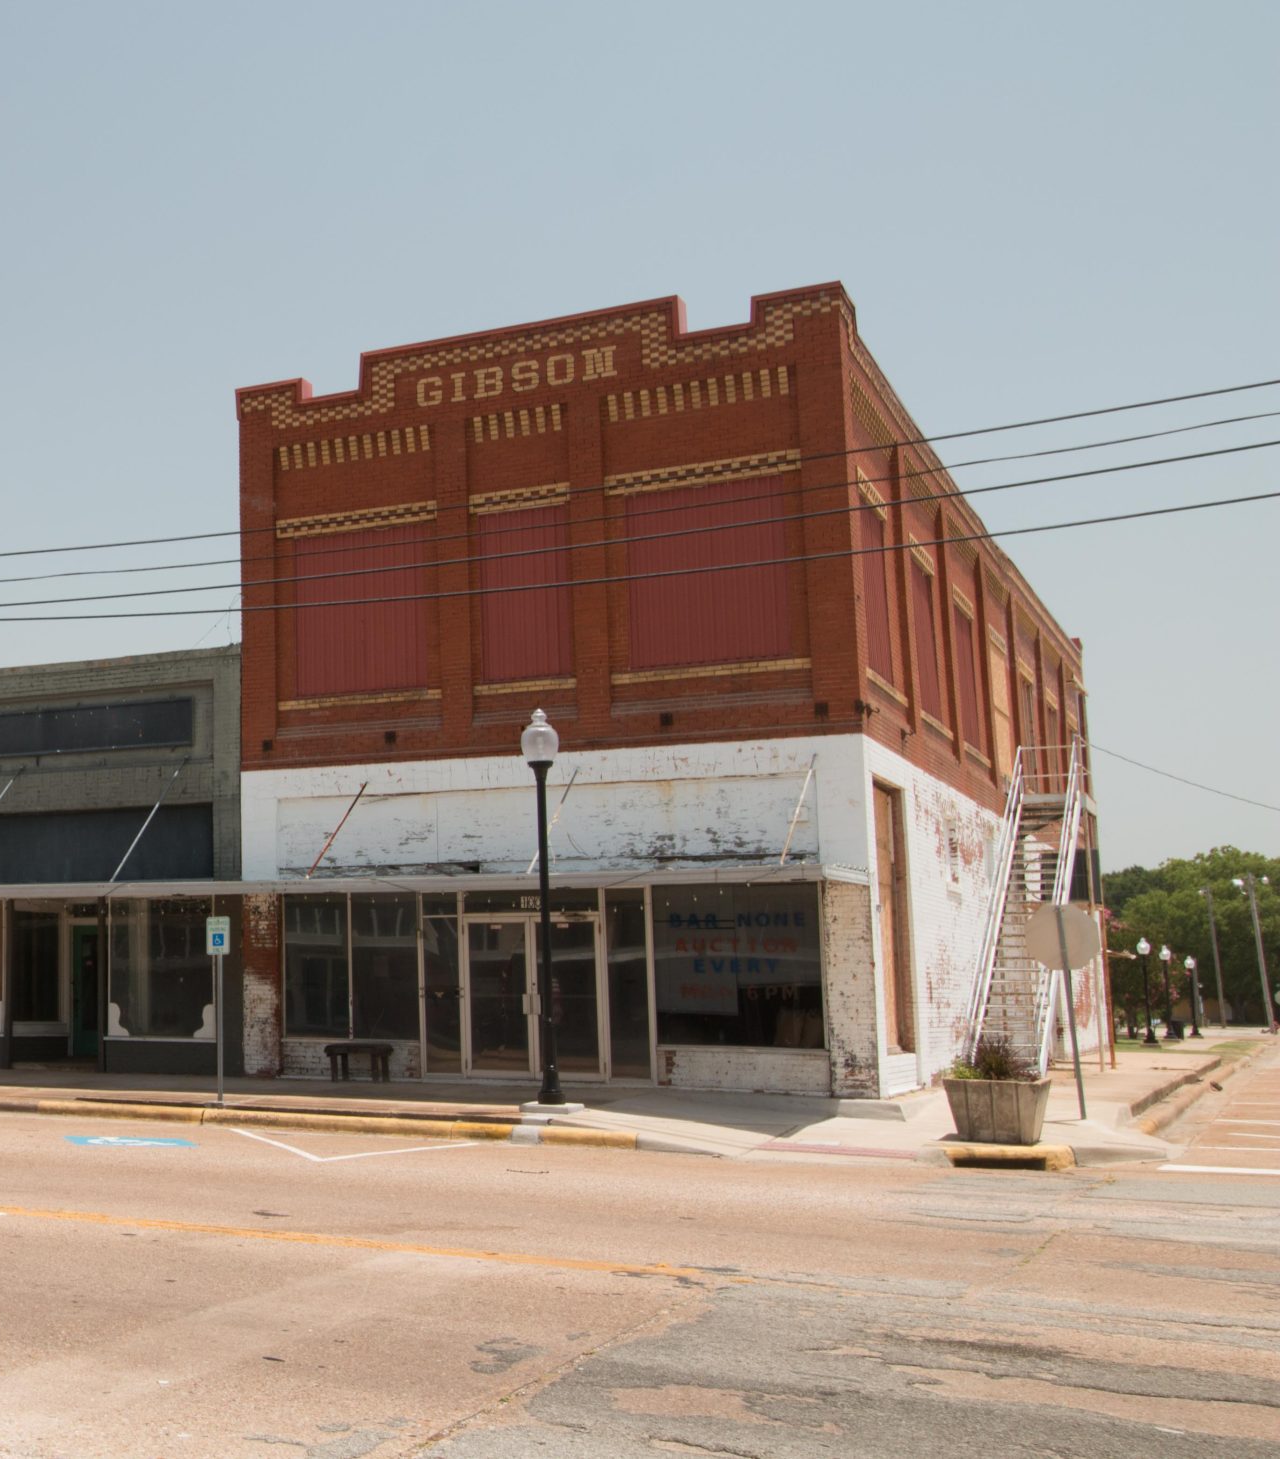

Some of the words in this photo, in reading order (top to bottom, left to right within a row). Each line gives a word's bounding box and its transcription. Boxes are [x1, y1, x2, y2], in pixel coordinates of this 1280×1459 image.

[416, 345, 618, 407] GIBSON
[669, 912, 718, 928] BAR
[736, 911, 806, 927] NONE
[675, 936, 799, 953] AUCTION
[693, 958, 780, 973] EVERY
